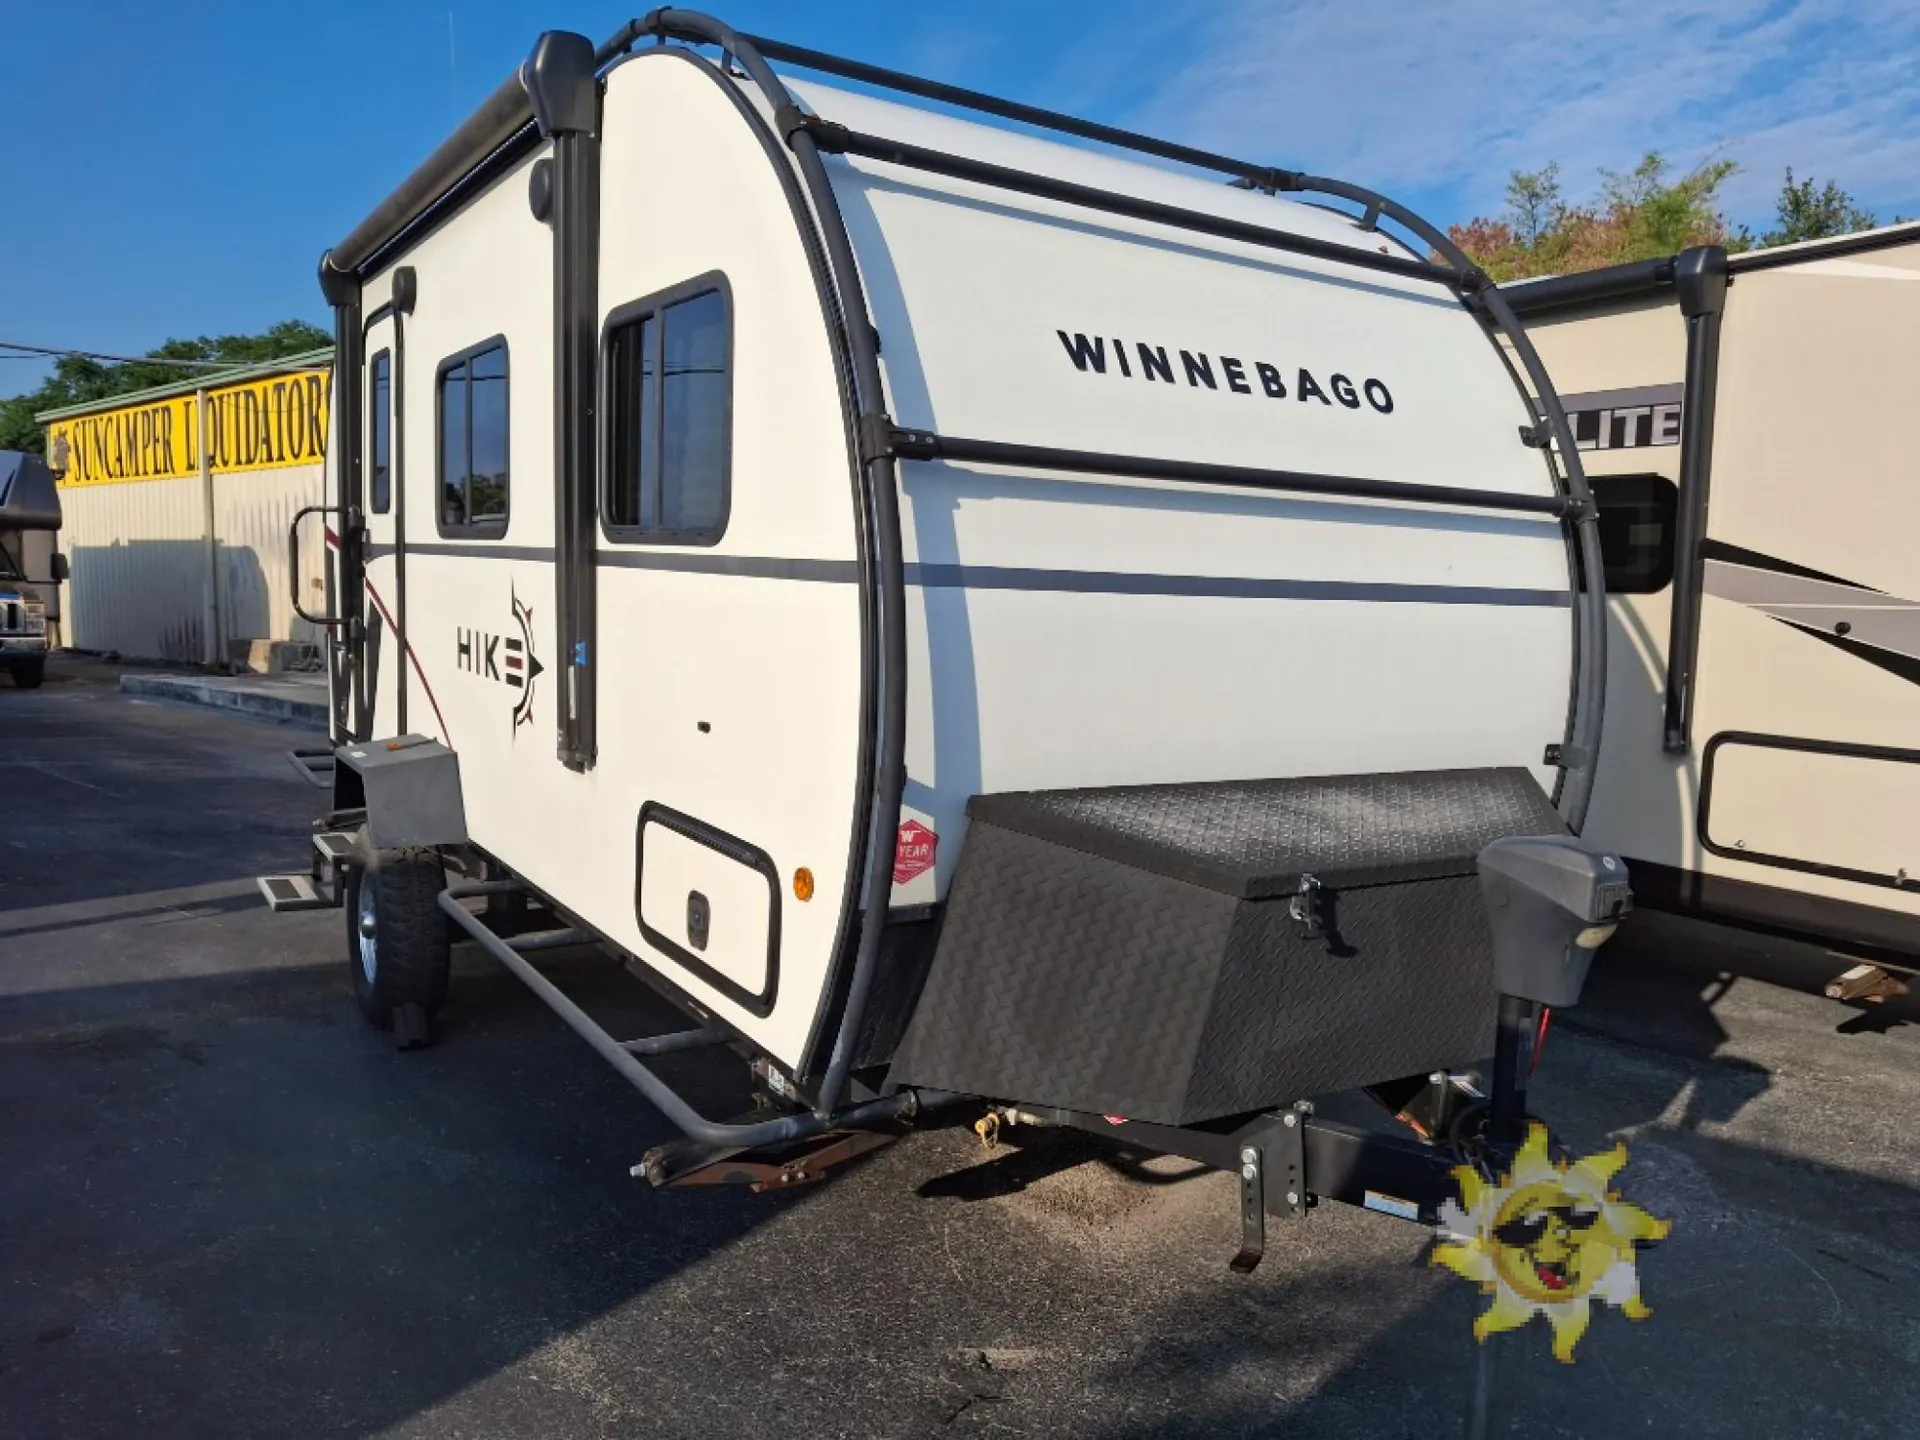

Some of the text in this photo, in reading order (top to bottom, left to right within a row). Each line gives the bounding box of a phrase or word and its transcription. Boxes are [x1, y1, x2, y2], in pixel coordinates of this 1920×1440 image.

[1056, 330, 1394, 414] WINNEBAGO
[72, 374, 331, 483] SUNCAMPER LQUIDATOR
[457, 625, 523, 689] HIKE
[899, 843, 929, 858] YEAR
